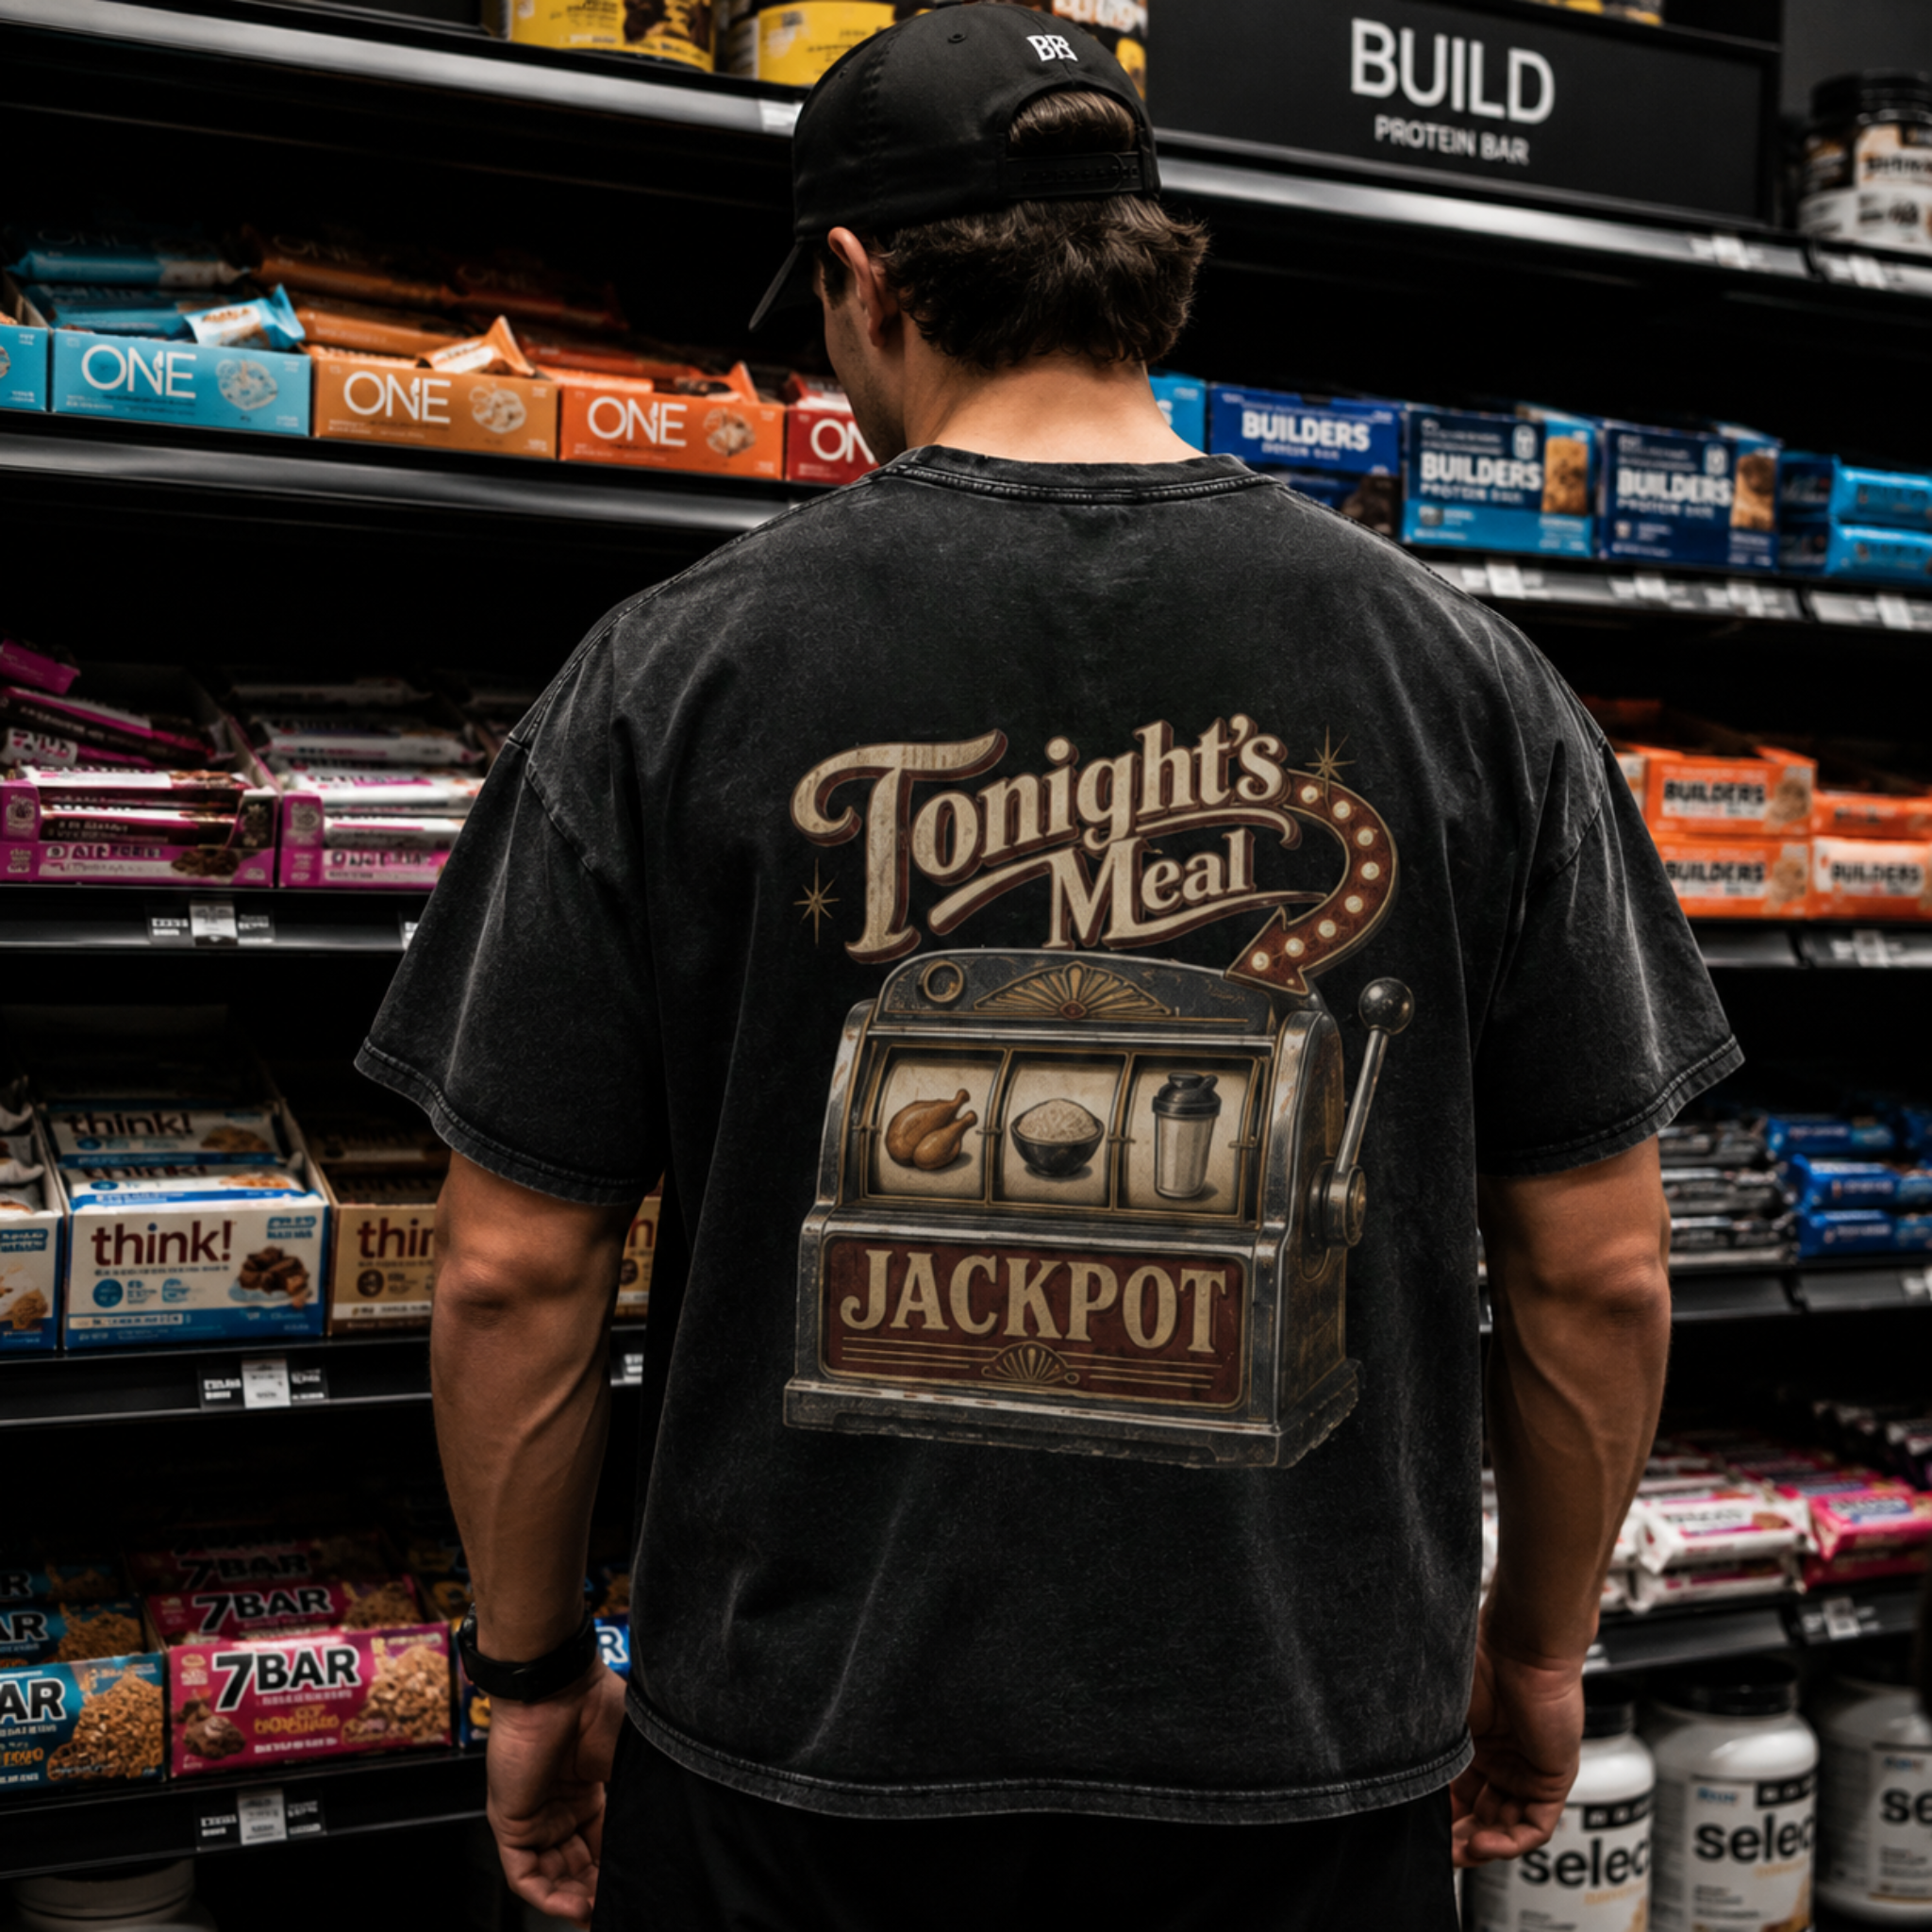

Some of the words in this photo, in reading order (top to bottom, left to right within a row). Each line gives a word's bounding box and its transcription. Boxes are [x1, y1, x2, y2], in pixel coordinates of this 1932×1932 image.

[1352, 18, 1555, 124] BUILD
[1374, 114, 1475, 158] PROTEIN
[1479, 131, 1529, 165] BAR
[81, 343, 196, 399] ONE
[343, 370, 451, 424] ONE
[588, 396, 687, 447] ONE
[1241, 410, 1371, 452] BUILDERS
[1421, 451, 1542, 491] BUILDERS
[1617, 468, 1734, 508] BUILDERS
[1663, 778, 1766, 804] BUILDERS
[790, 714, 1291, 964] Tonight's
[1830, 861, 1922, 884] BUILDERS
[62, 1112, 193, 1136] think!
[91, 1221, 234, 1266] think!
[839, 1248, 1226, 1355] JACKPOT
[192, 1587, 334, 1635] 7BAR
[212, 1644, 361, 1712] 7BAR
